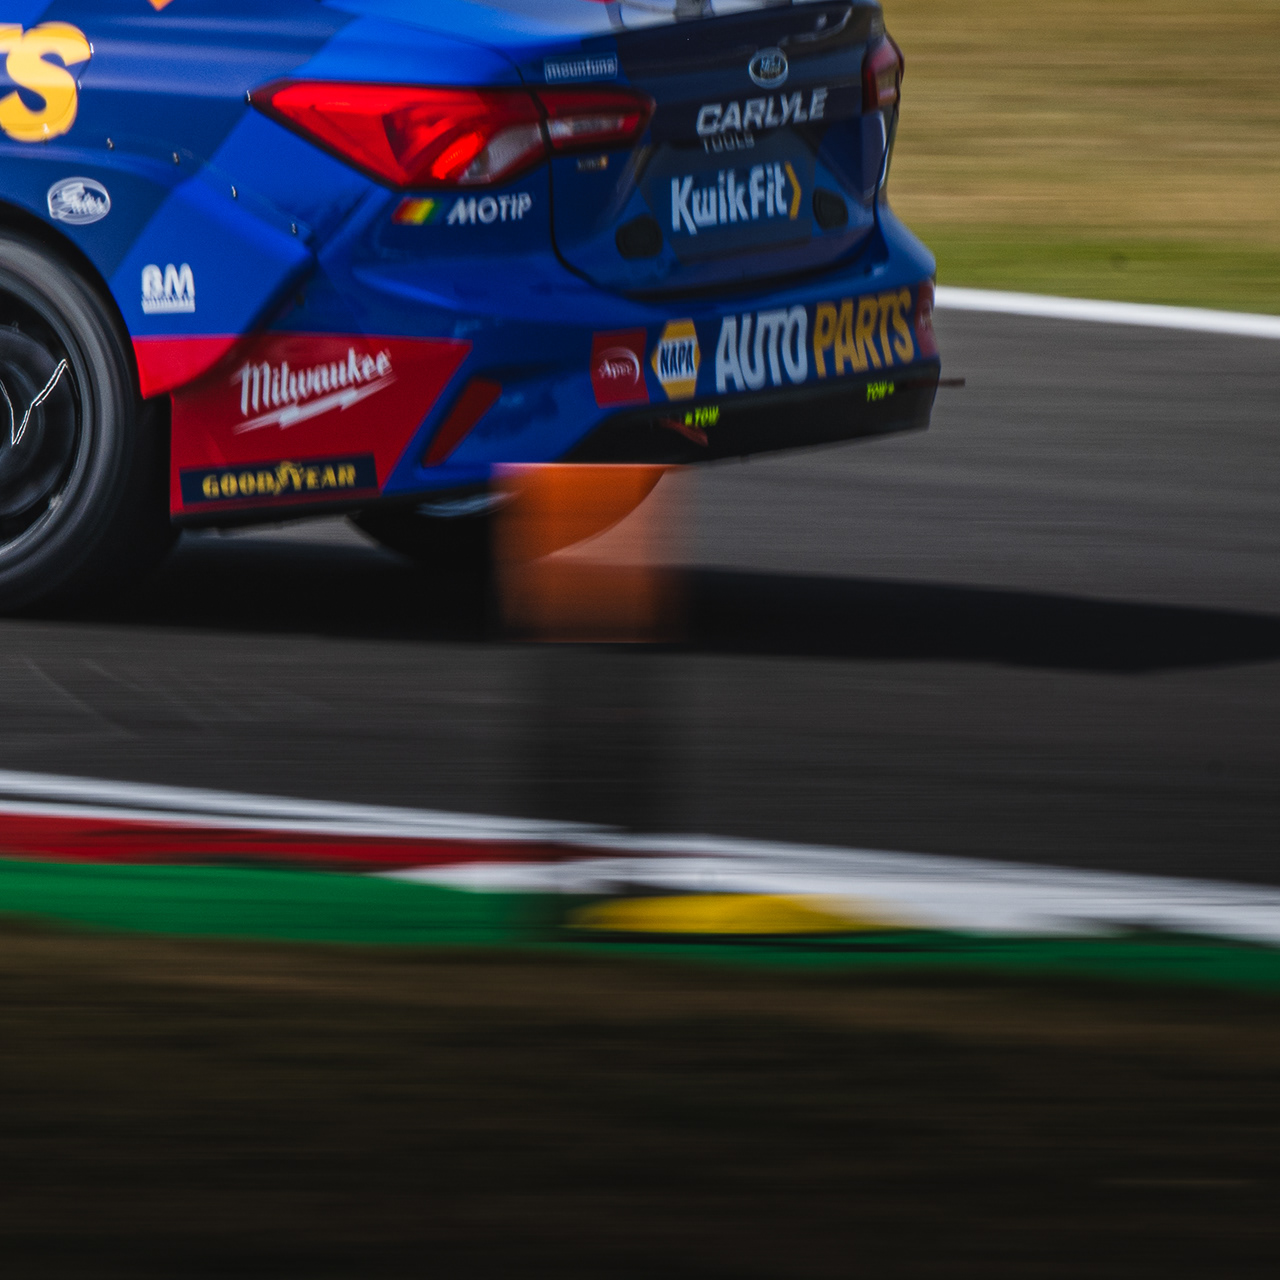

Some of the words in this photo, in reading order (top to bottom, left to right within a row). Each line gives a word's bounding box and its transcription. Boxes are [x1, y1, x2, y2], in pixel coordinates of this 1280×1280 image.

[696, 86, 828, 136] CARLYLE
[446, 192, 533, 226] MOTIP
[659, 340, 696, 379] NAPA
[715, 304, 809, 394] AUTO
[813, 287, 916, 379] PARTS
[239, 347, 393, 417] Milwaukee
[866, 381, 888, 402] TOW
[694, 406, 720, 427] TOW
[201, 461, 357, 499] GOODYEAR
